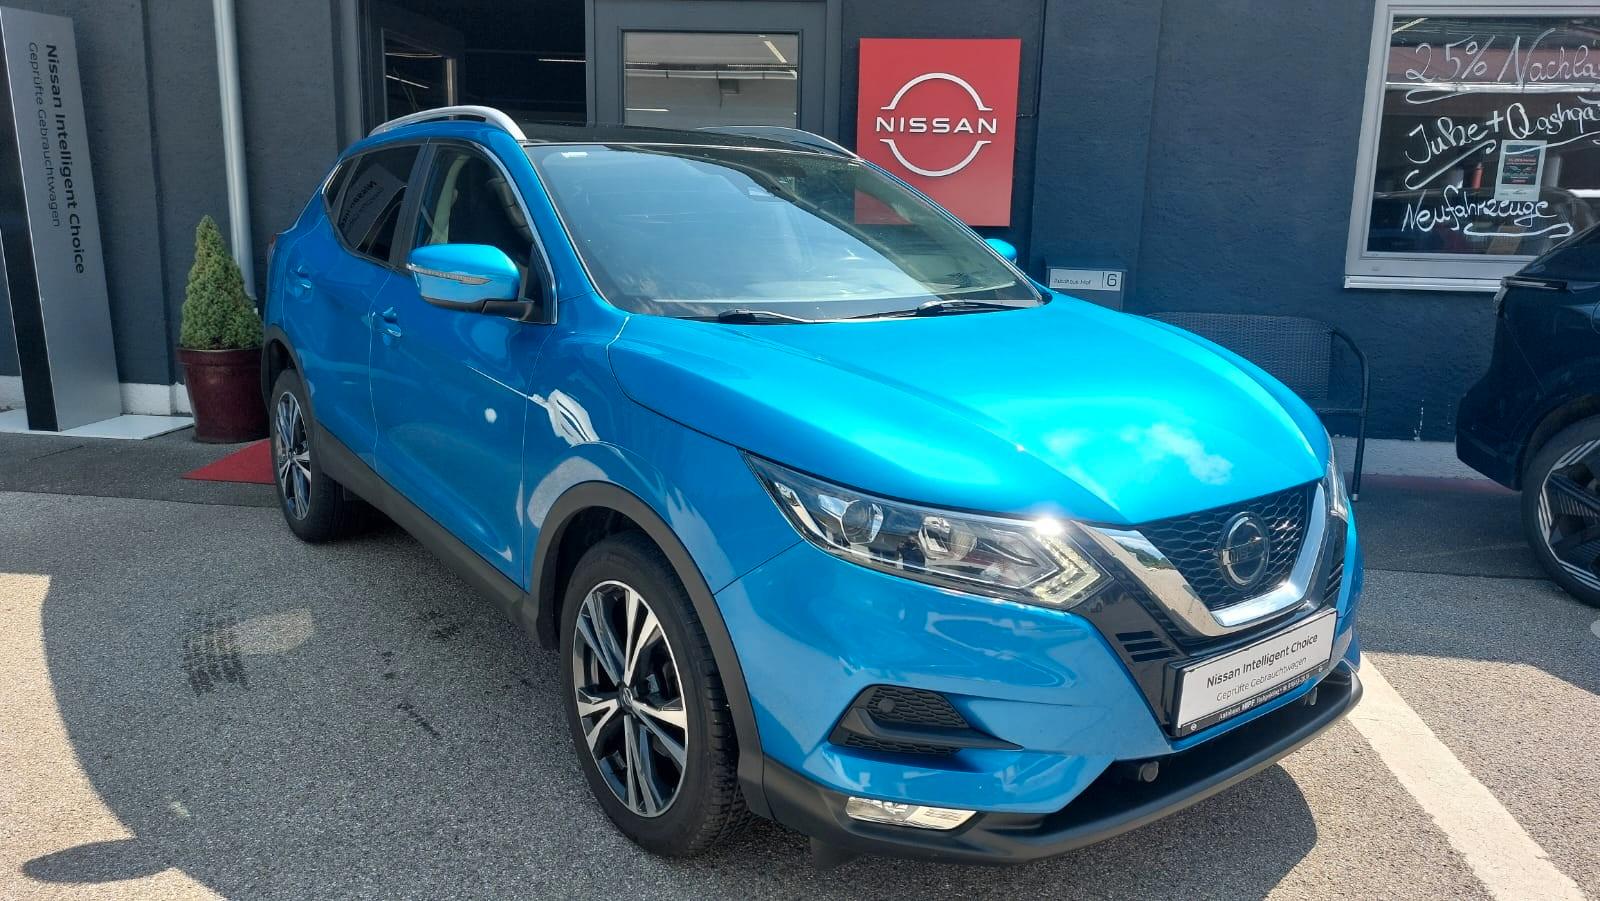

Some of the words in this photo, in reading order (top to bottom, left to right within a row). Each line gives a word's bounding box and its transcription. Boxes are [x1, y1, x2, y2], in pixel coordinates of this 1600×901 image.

[1405, 34, 1496, 83] 25%
[1497, 28, 1600, 89] Nachla
[28, 41, 45, 105] Geprüfte
[37, 110, 61, 228] Gebrauchtwagen
[875, 116, 998, 134] NISSAN
[1507, 102, 1600, 139] Qashqa
[46, 44, 63, 107] Nissan
[55, 113, 78, 209] Intelligent
[69, 213, 85, 274] Choice
[1402, 181, 1557, 232] Neufahrzeuge
[1106, 273, 1118, 287] 6
[1206, 667, 1241, 688] Nissan
[1242, 646, 1290, 674] Intelligent
[1290, 633, 1319, 654] Choice
[1216, 681, 1251, 702] Geprüfte
[1250, 656, 1308, 689] Gebrauchtwagen
